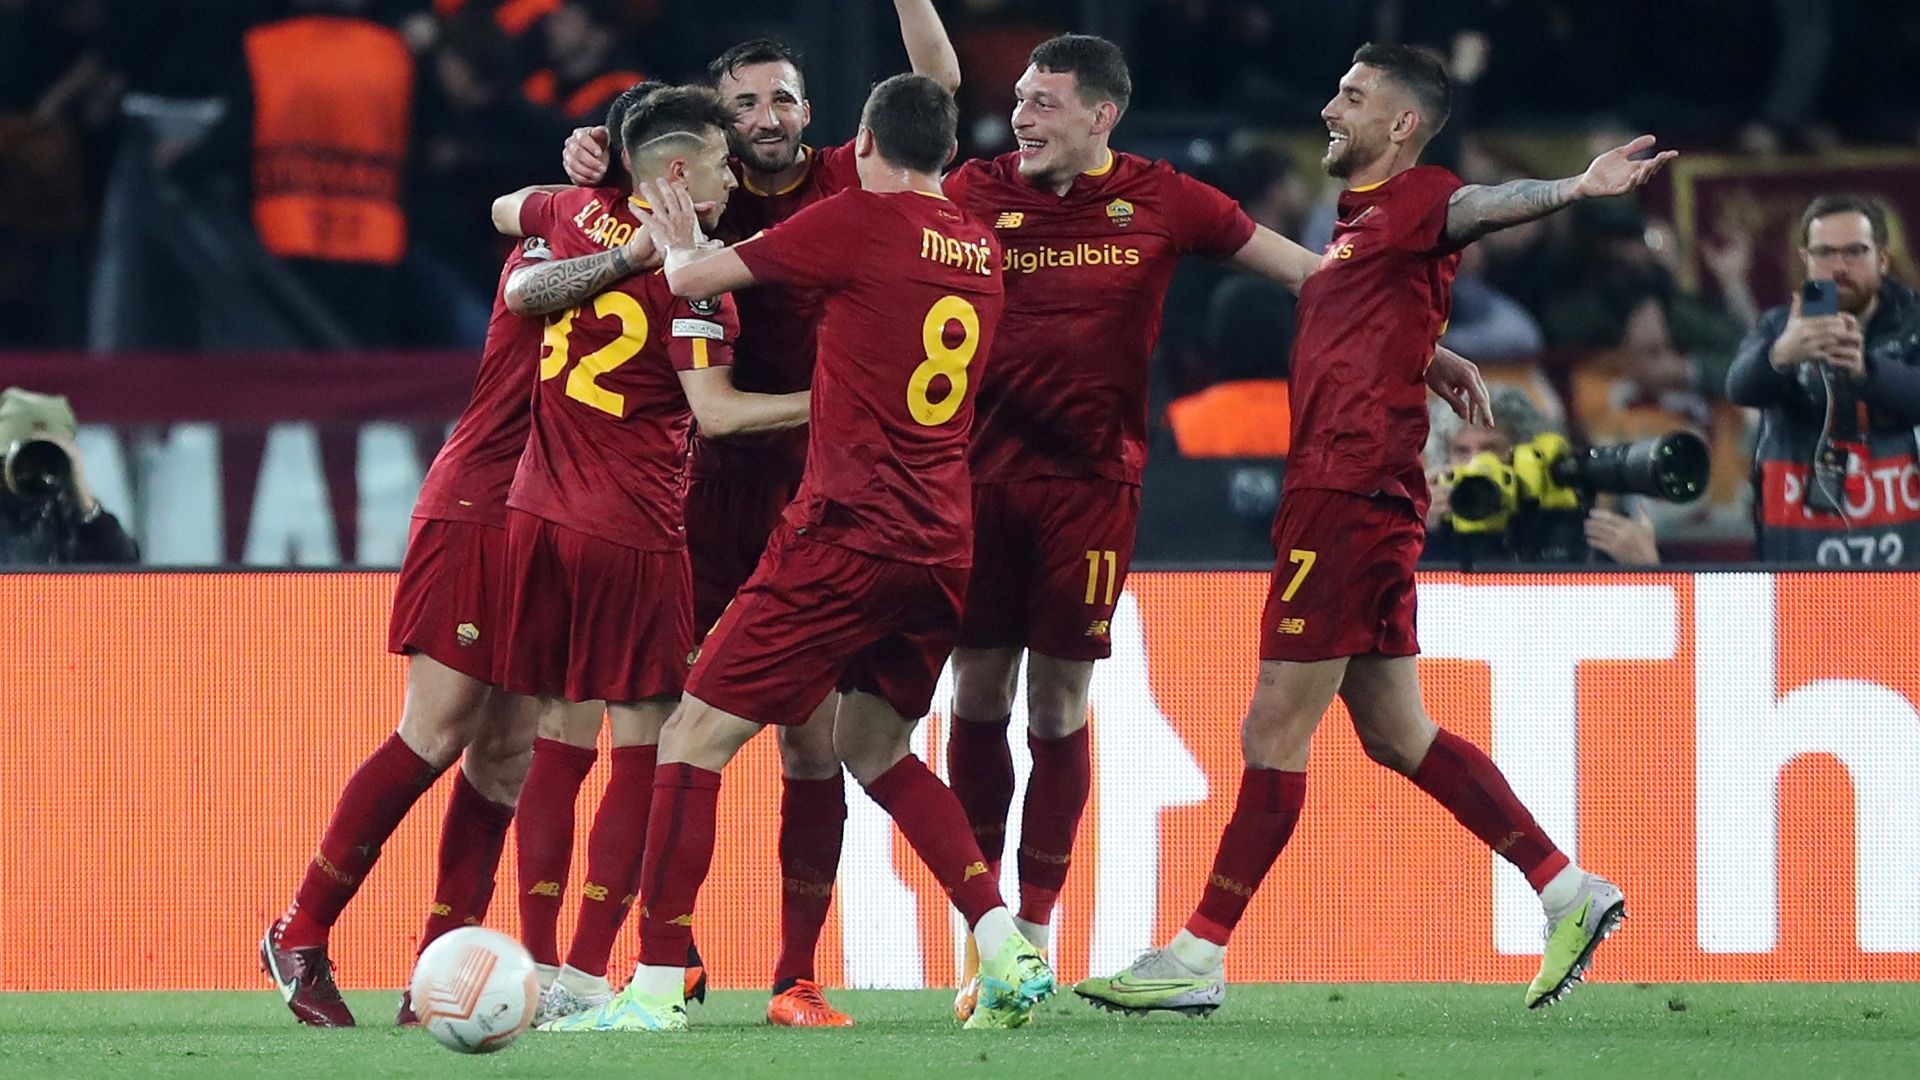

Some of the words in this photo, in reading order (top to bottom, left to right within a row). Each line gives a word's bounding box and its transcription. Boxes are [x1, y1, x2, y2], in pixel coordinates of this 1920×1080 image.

[1001, 243, 1140, 273] digitalbits
[907, 295, 980, 426] 8
[1783, 452, 1920, 518] POTO
[1085, 551, 1116, 605] 11
[1281, 549, 1316, 602] 7
[1416, 573, 1920, 955] Th
